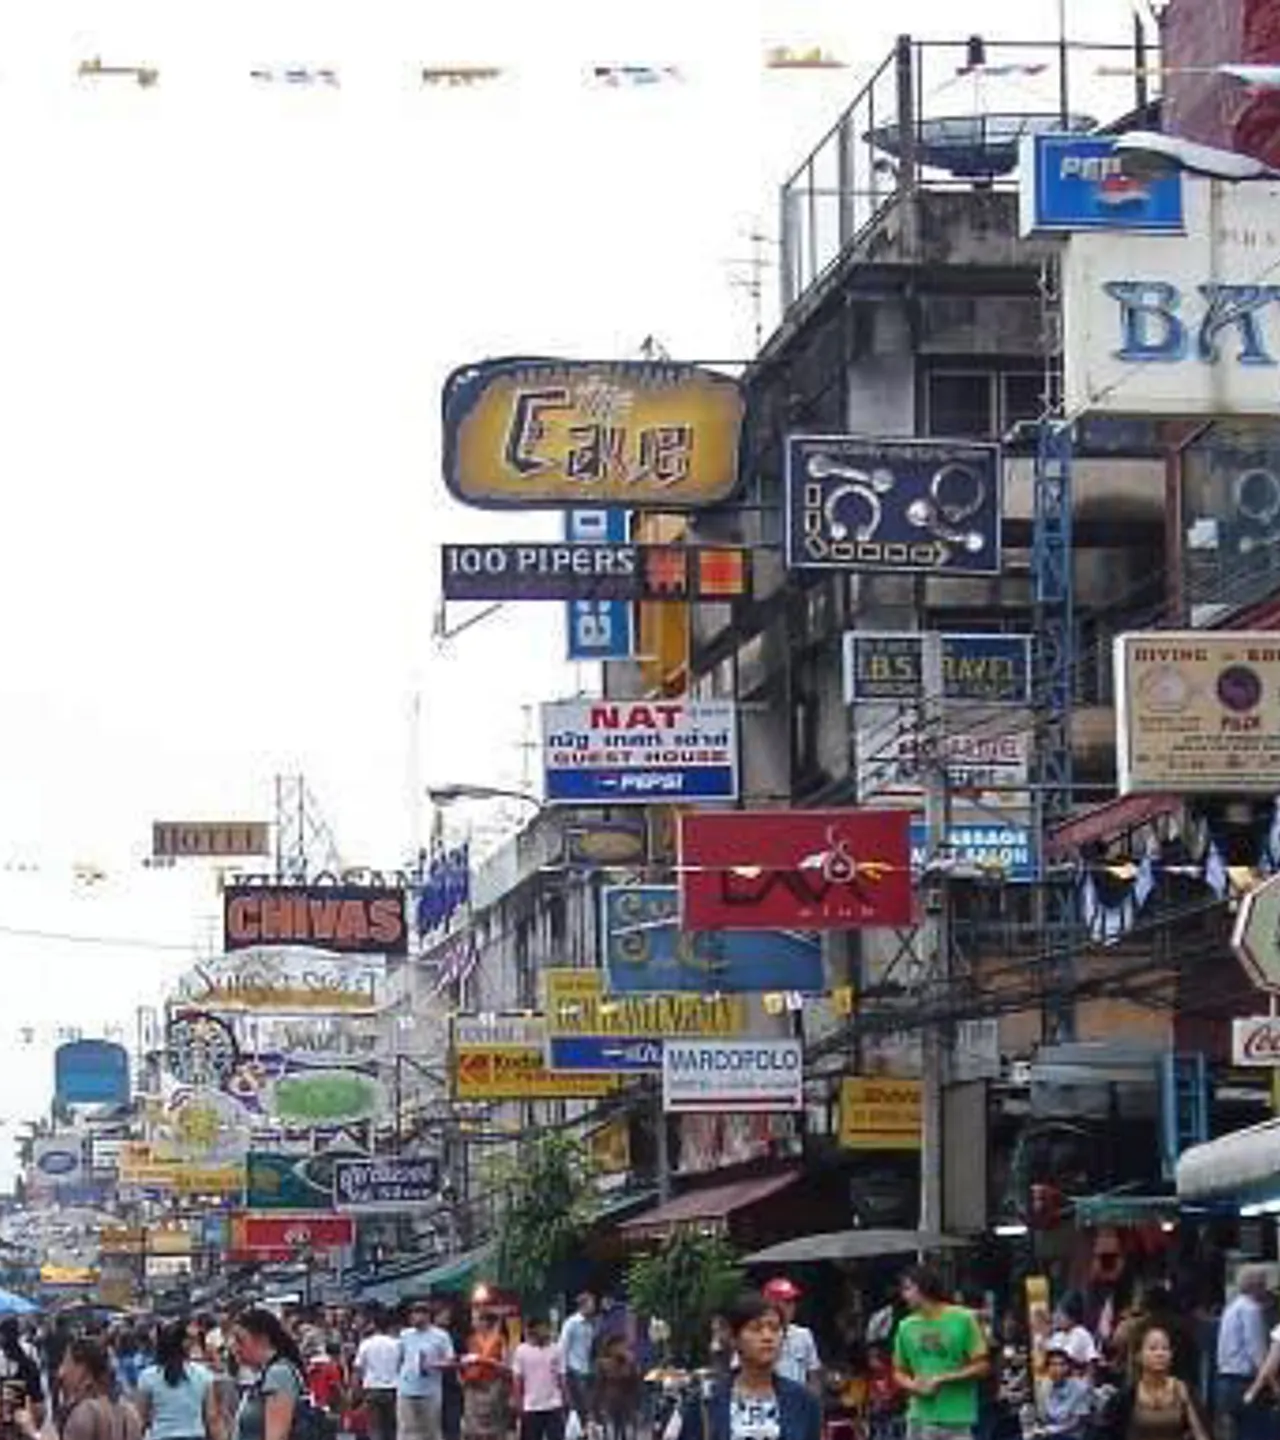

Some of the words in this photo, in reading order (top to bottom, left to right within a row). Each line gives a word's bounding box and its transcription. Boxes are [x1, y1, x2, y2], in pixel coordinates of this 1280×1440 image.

[449, 547, 508, 573] 100
[519, 547, 637, 574] PIPERS
[590, 705, 684, 729] NAT
[227, 896, 404, 943] CHIVAS
